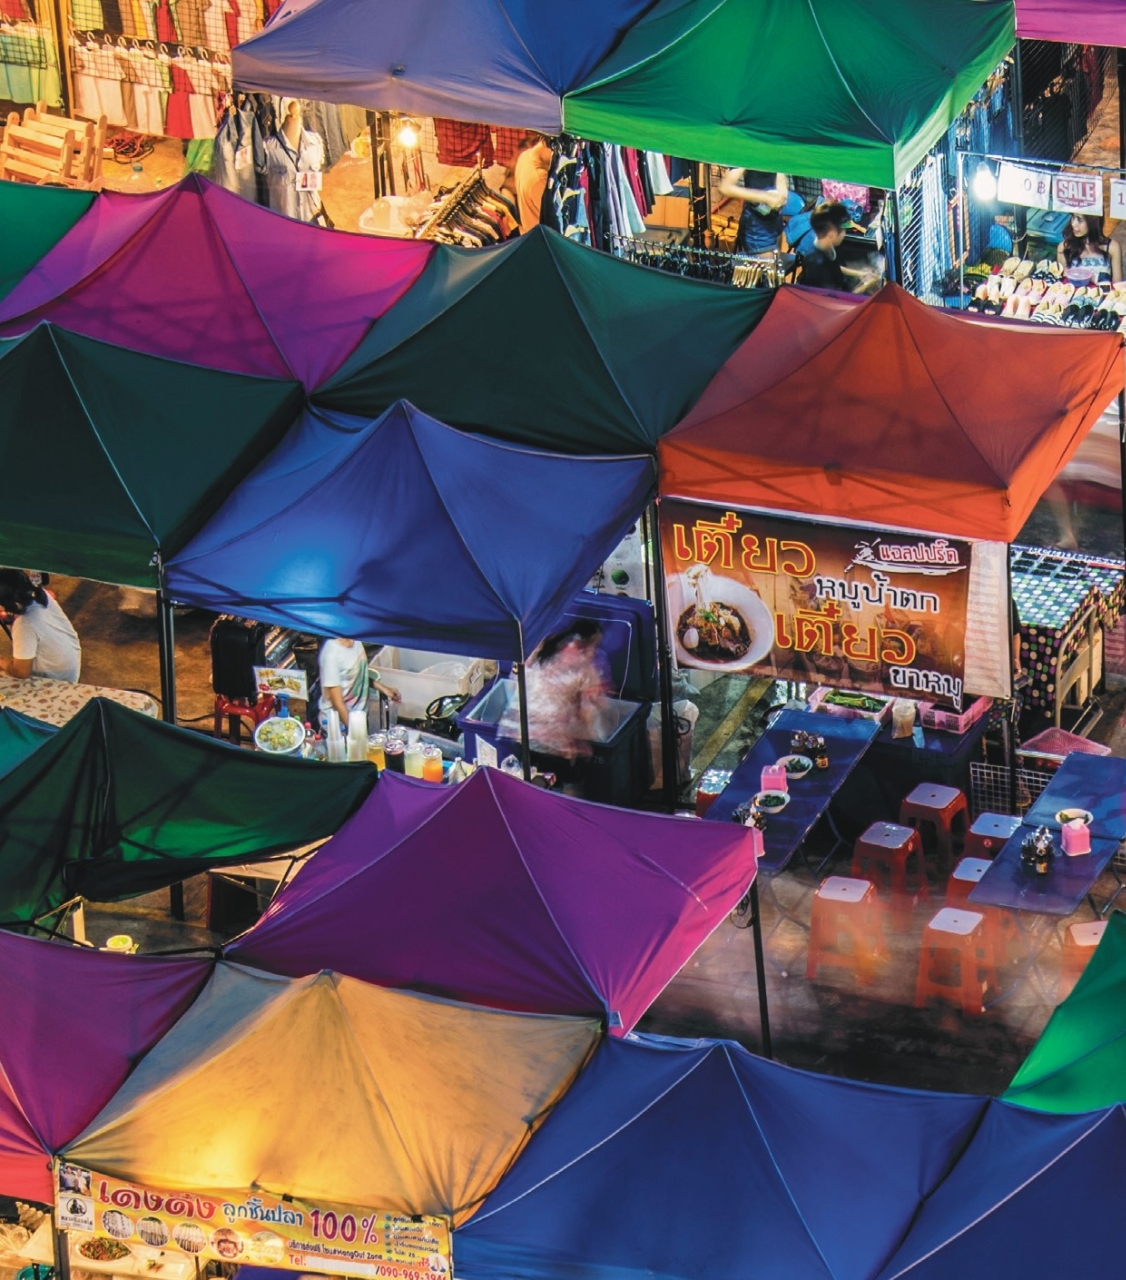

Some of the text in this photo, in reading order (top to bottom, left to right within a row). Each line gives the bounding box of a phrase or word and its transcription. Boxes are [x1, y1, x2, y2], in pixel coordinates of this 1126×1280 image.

[1058, 180, 1095, 201] SALE
[673, 512, 816, 579] เตี๋ยว
[814, 573, 939, 613] หมูน้ำตก
[775, 602, 917, 665] เตี๋ยว
[890, 667, 962, 708] ขาหมู
[223, 1198, 304, 1223] ลูกชิ้นปลา
[289, 1254, 307, 1267] Tel.
